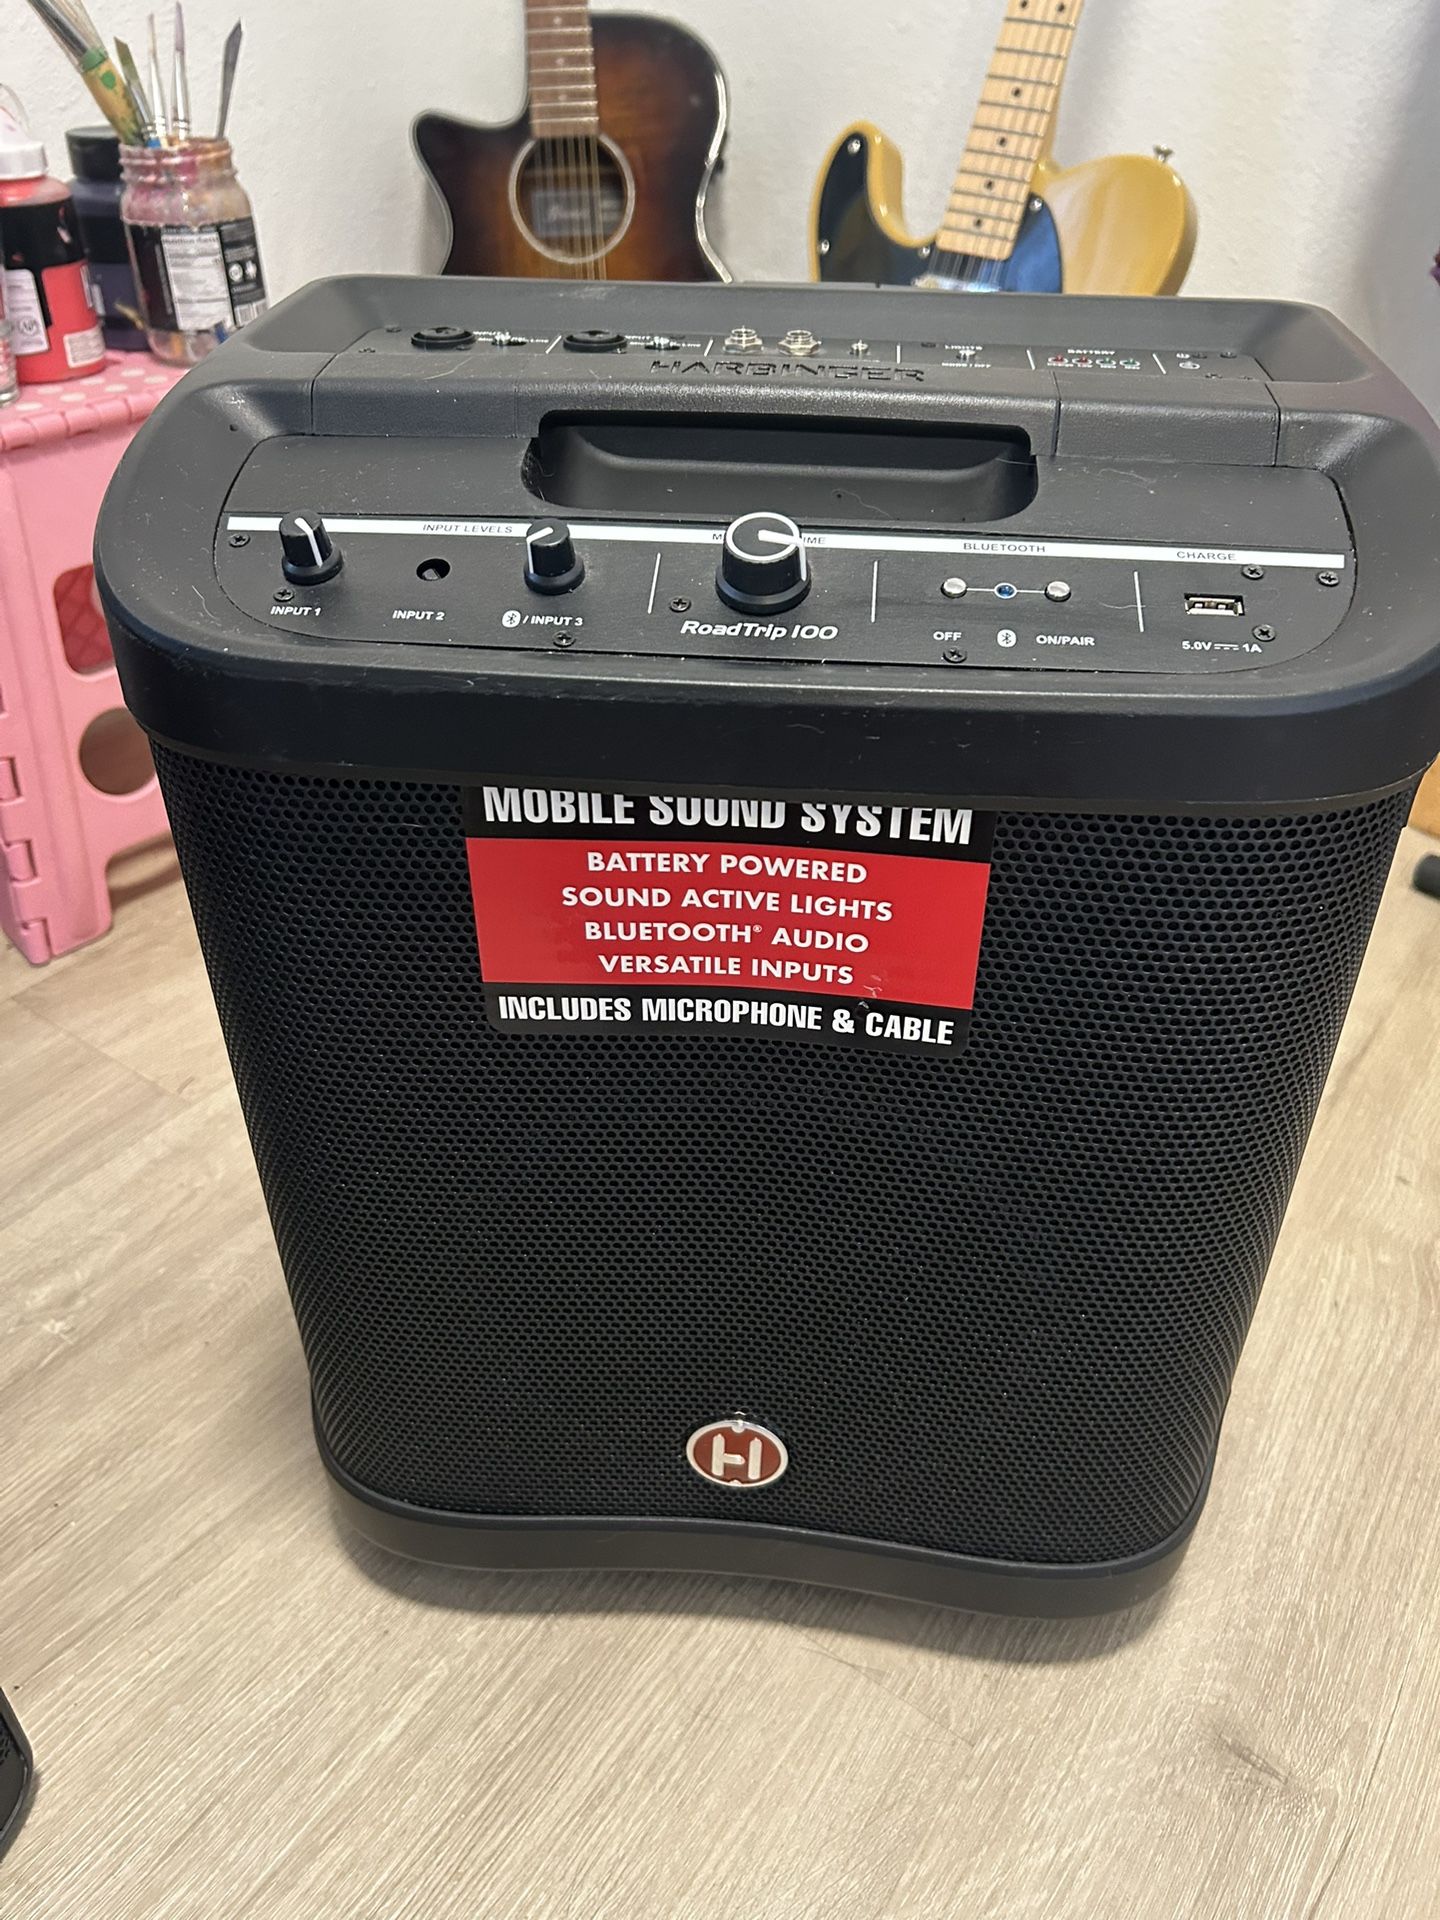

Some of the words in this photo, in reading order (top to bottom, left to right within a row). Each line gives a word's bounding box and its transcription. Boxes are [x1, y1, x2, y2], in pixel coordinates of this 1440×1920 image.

[650, 360, 925, 382] HARBINGER
[422, 524, 461, 533] INPUT
[463, 525, 513, 534] LEVELS
[963, 542, 1046, 553] BLUETOOTH
[1177, 551, 1236, 561] CHARGE
[270, 606, 313, 617] INPUT
[315, 607, 321, 617] 1
[392, 610, 436, 621] INPUT
[435, 611, 446, 621] 2
[531, 615, 574, 627] INPUT
[573, 616, 583, 626] 3
[680, 620, 788, 640] RoadTrip
[933, 631, 962, 641] OFF
[1036, 635, 1095, 646] ON/PAIR
[1182, 641, 1212, 651] 5.0V
[1242, 643, 1263, 653] 1A
[482, 786, 636, 825] MOBILE
[649, 796, 786, 829] SOUND
[801, 802, 973, 845] SYSTEM
[587, 851, 711, 873] BATTERY
[720, 854, 868, 884] POWERED
[562, 886, 672, 907] SOUND
[681, 888, 780, 912] ACTIVE
[790, 893, 894, 922] LIGHTS
[771, 927, 870, 953] AUDIO
[597, 955, 742, 975] VERSATILE
[751, 958, 854, 985] INPUTS
[498, 995, 632, 1022] INCLUDES
[641, 998, 823, 1031] MICROPHONE
[831, 1008, 855, 1034] &
[865, 1012, 955, 1045] CABLE
[711, 1433, 763, 1480] H
